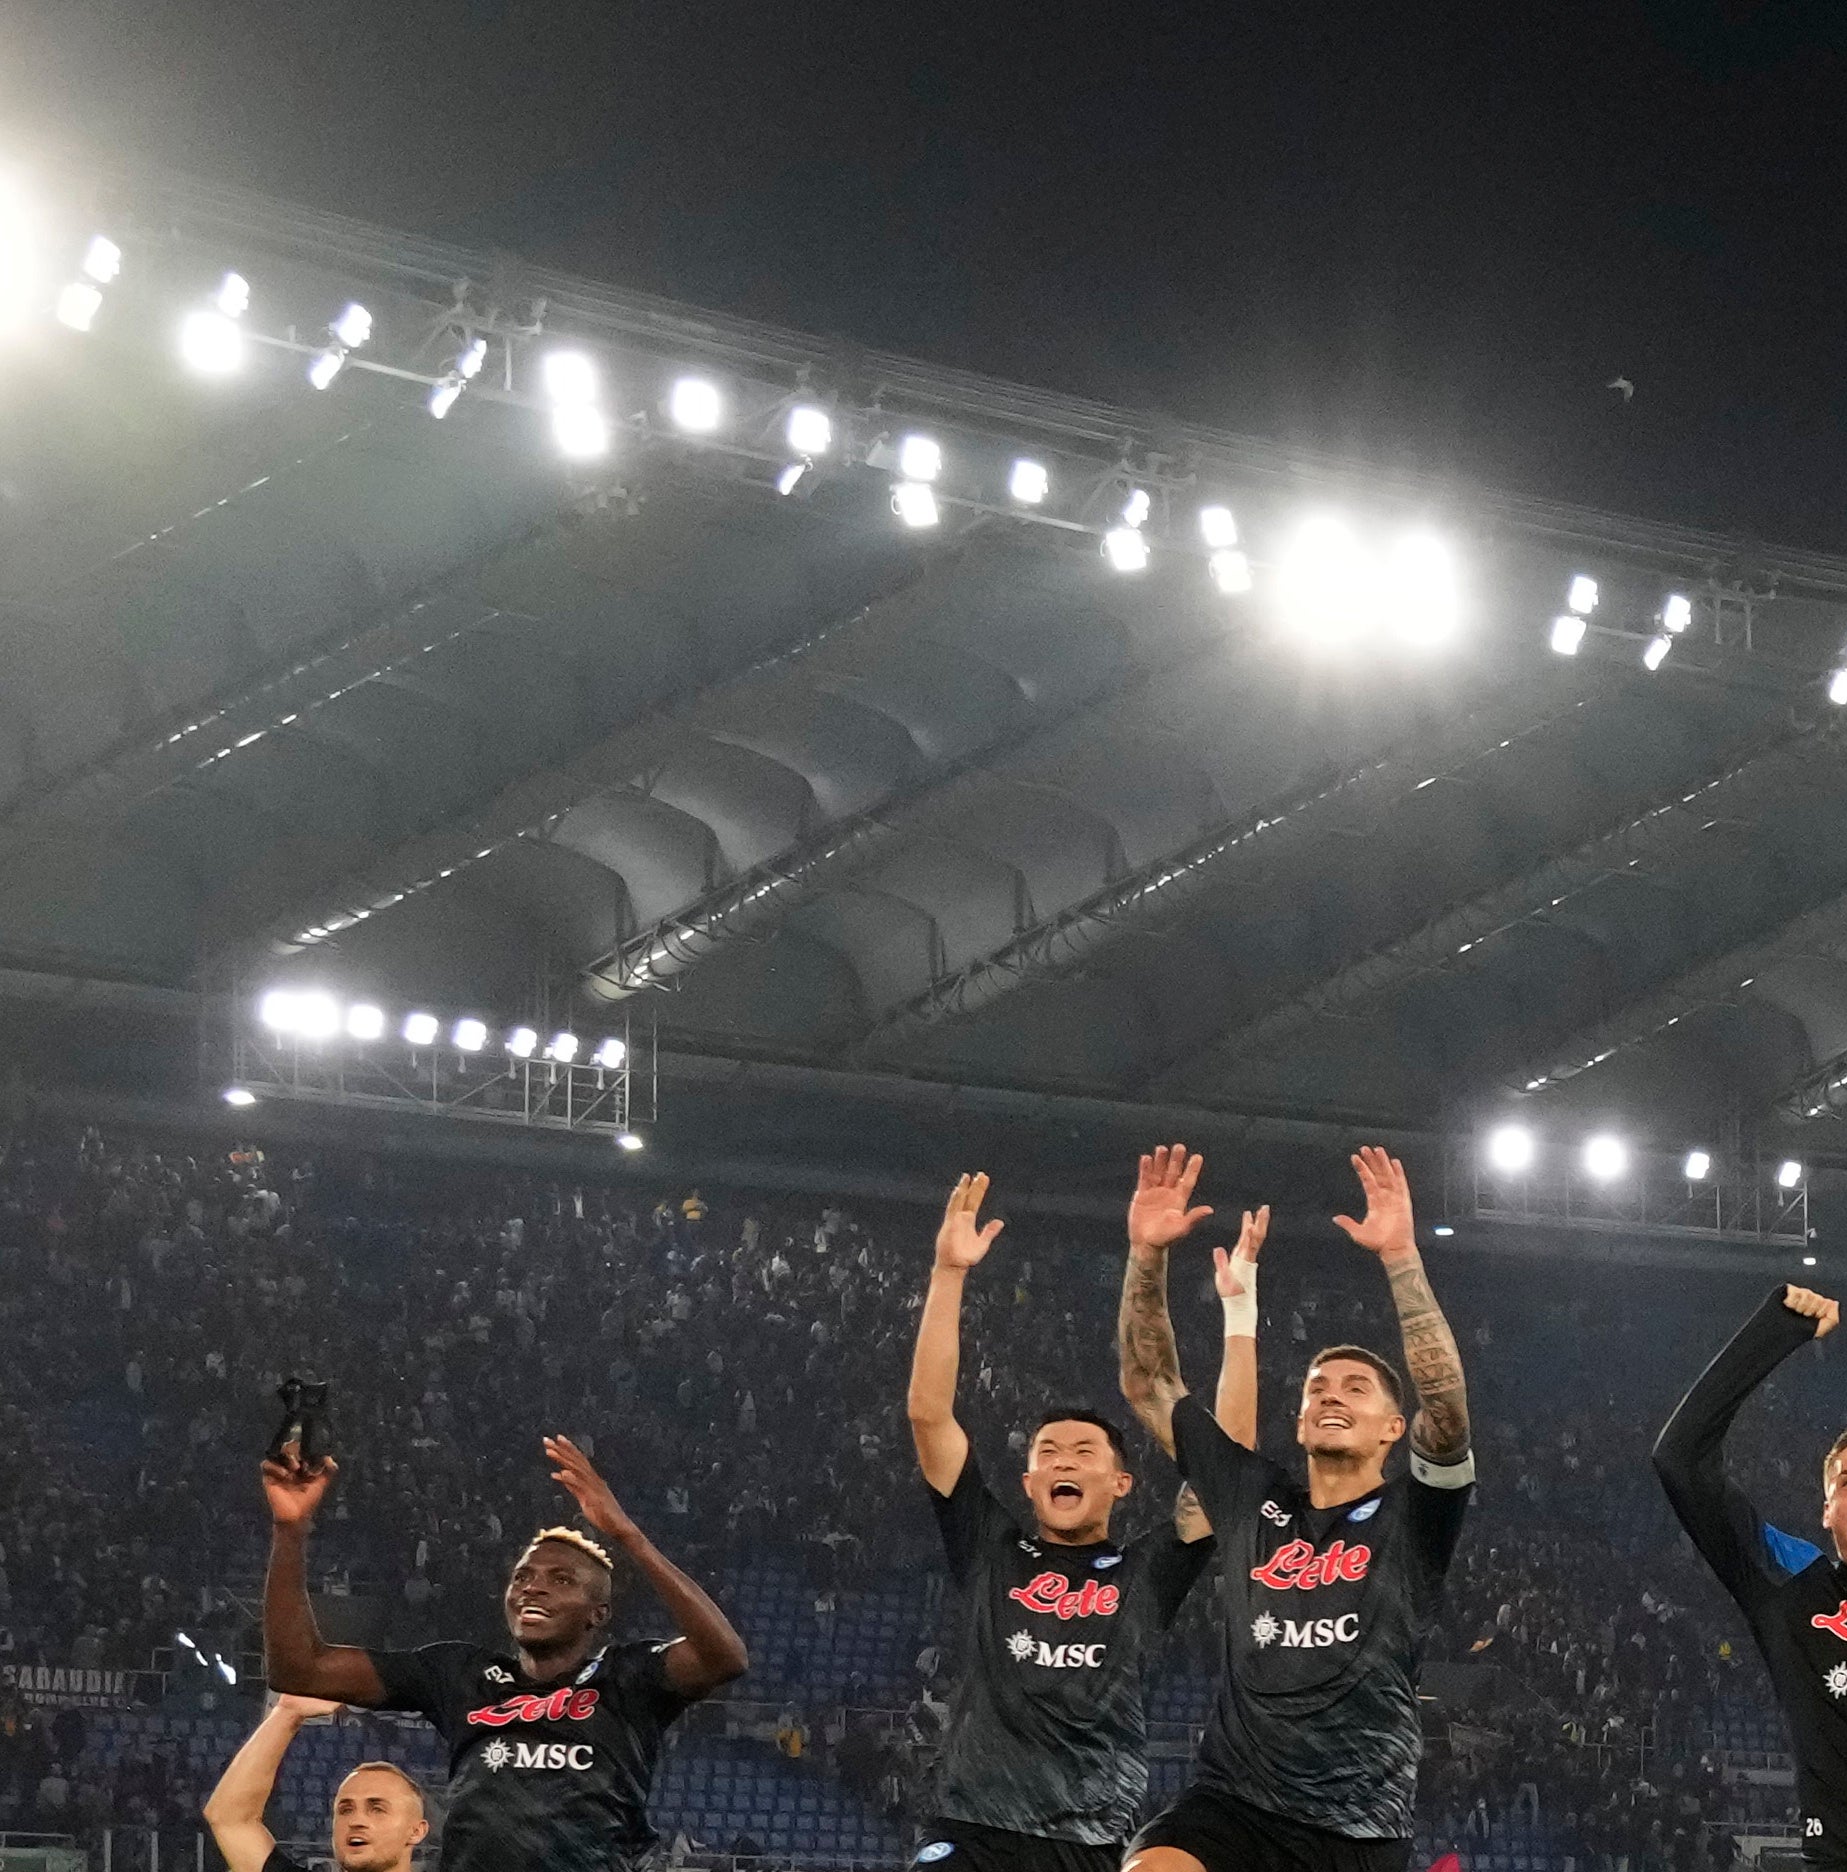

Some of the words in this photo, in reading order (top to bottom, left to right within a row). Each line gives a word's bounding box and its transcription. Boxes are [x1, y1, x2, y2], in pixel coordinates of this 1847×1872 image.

[1251, 1539, 1372, 1590] Lete
[1010, 1570, 1119, 1620] Lete
[1280, 1613, 1359, 1648] MSC
[1034, 1642, 1106, 1669] MSC
[467, 1686, 599, 1726] Lete
[514, 1743, 594, 1770] MSC
